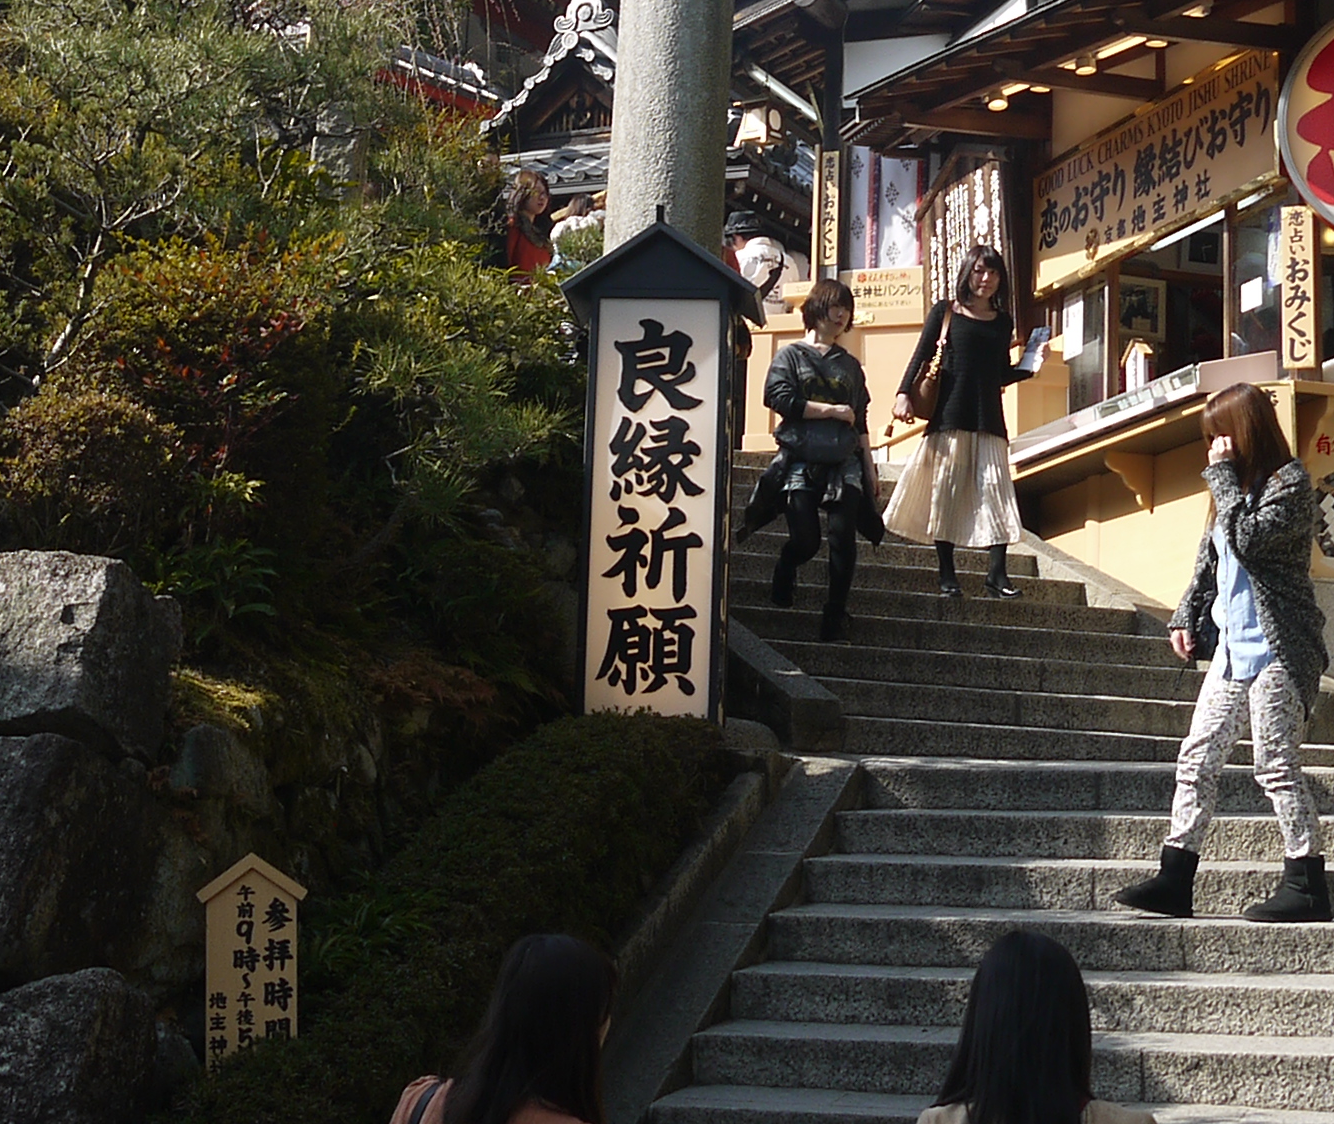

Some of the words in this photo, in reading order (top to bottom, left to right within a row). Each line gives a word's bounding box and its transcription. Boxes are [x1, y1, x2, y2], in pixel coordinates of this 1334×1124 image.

[1038, 168, 1065, 199] GOOD
[1067, 149, 1095, 182] LUCK
[1097, 120, 1144, 165] CHARMS
[1147, 98, 1184, 137] KYOTO
[1187, 75, 1221, 118] JISHU
[1224, 50, 1271, 93] SHRINE
[1038, 163, 1127, 251] 恋のお守り
[1133, 82, 1271, 199] 縁結びお守り
[822, 156, 836, 260] 恋占いおみくじ
[1284, 210, 1312, 363] 恋占いおみくじ
[595, 318, 706, 696] 良縁祈願
